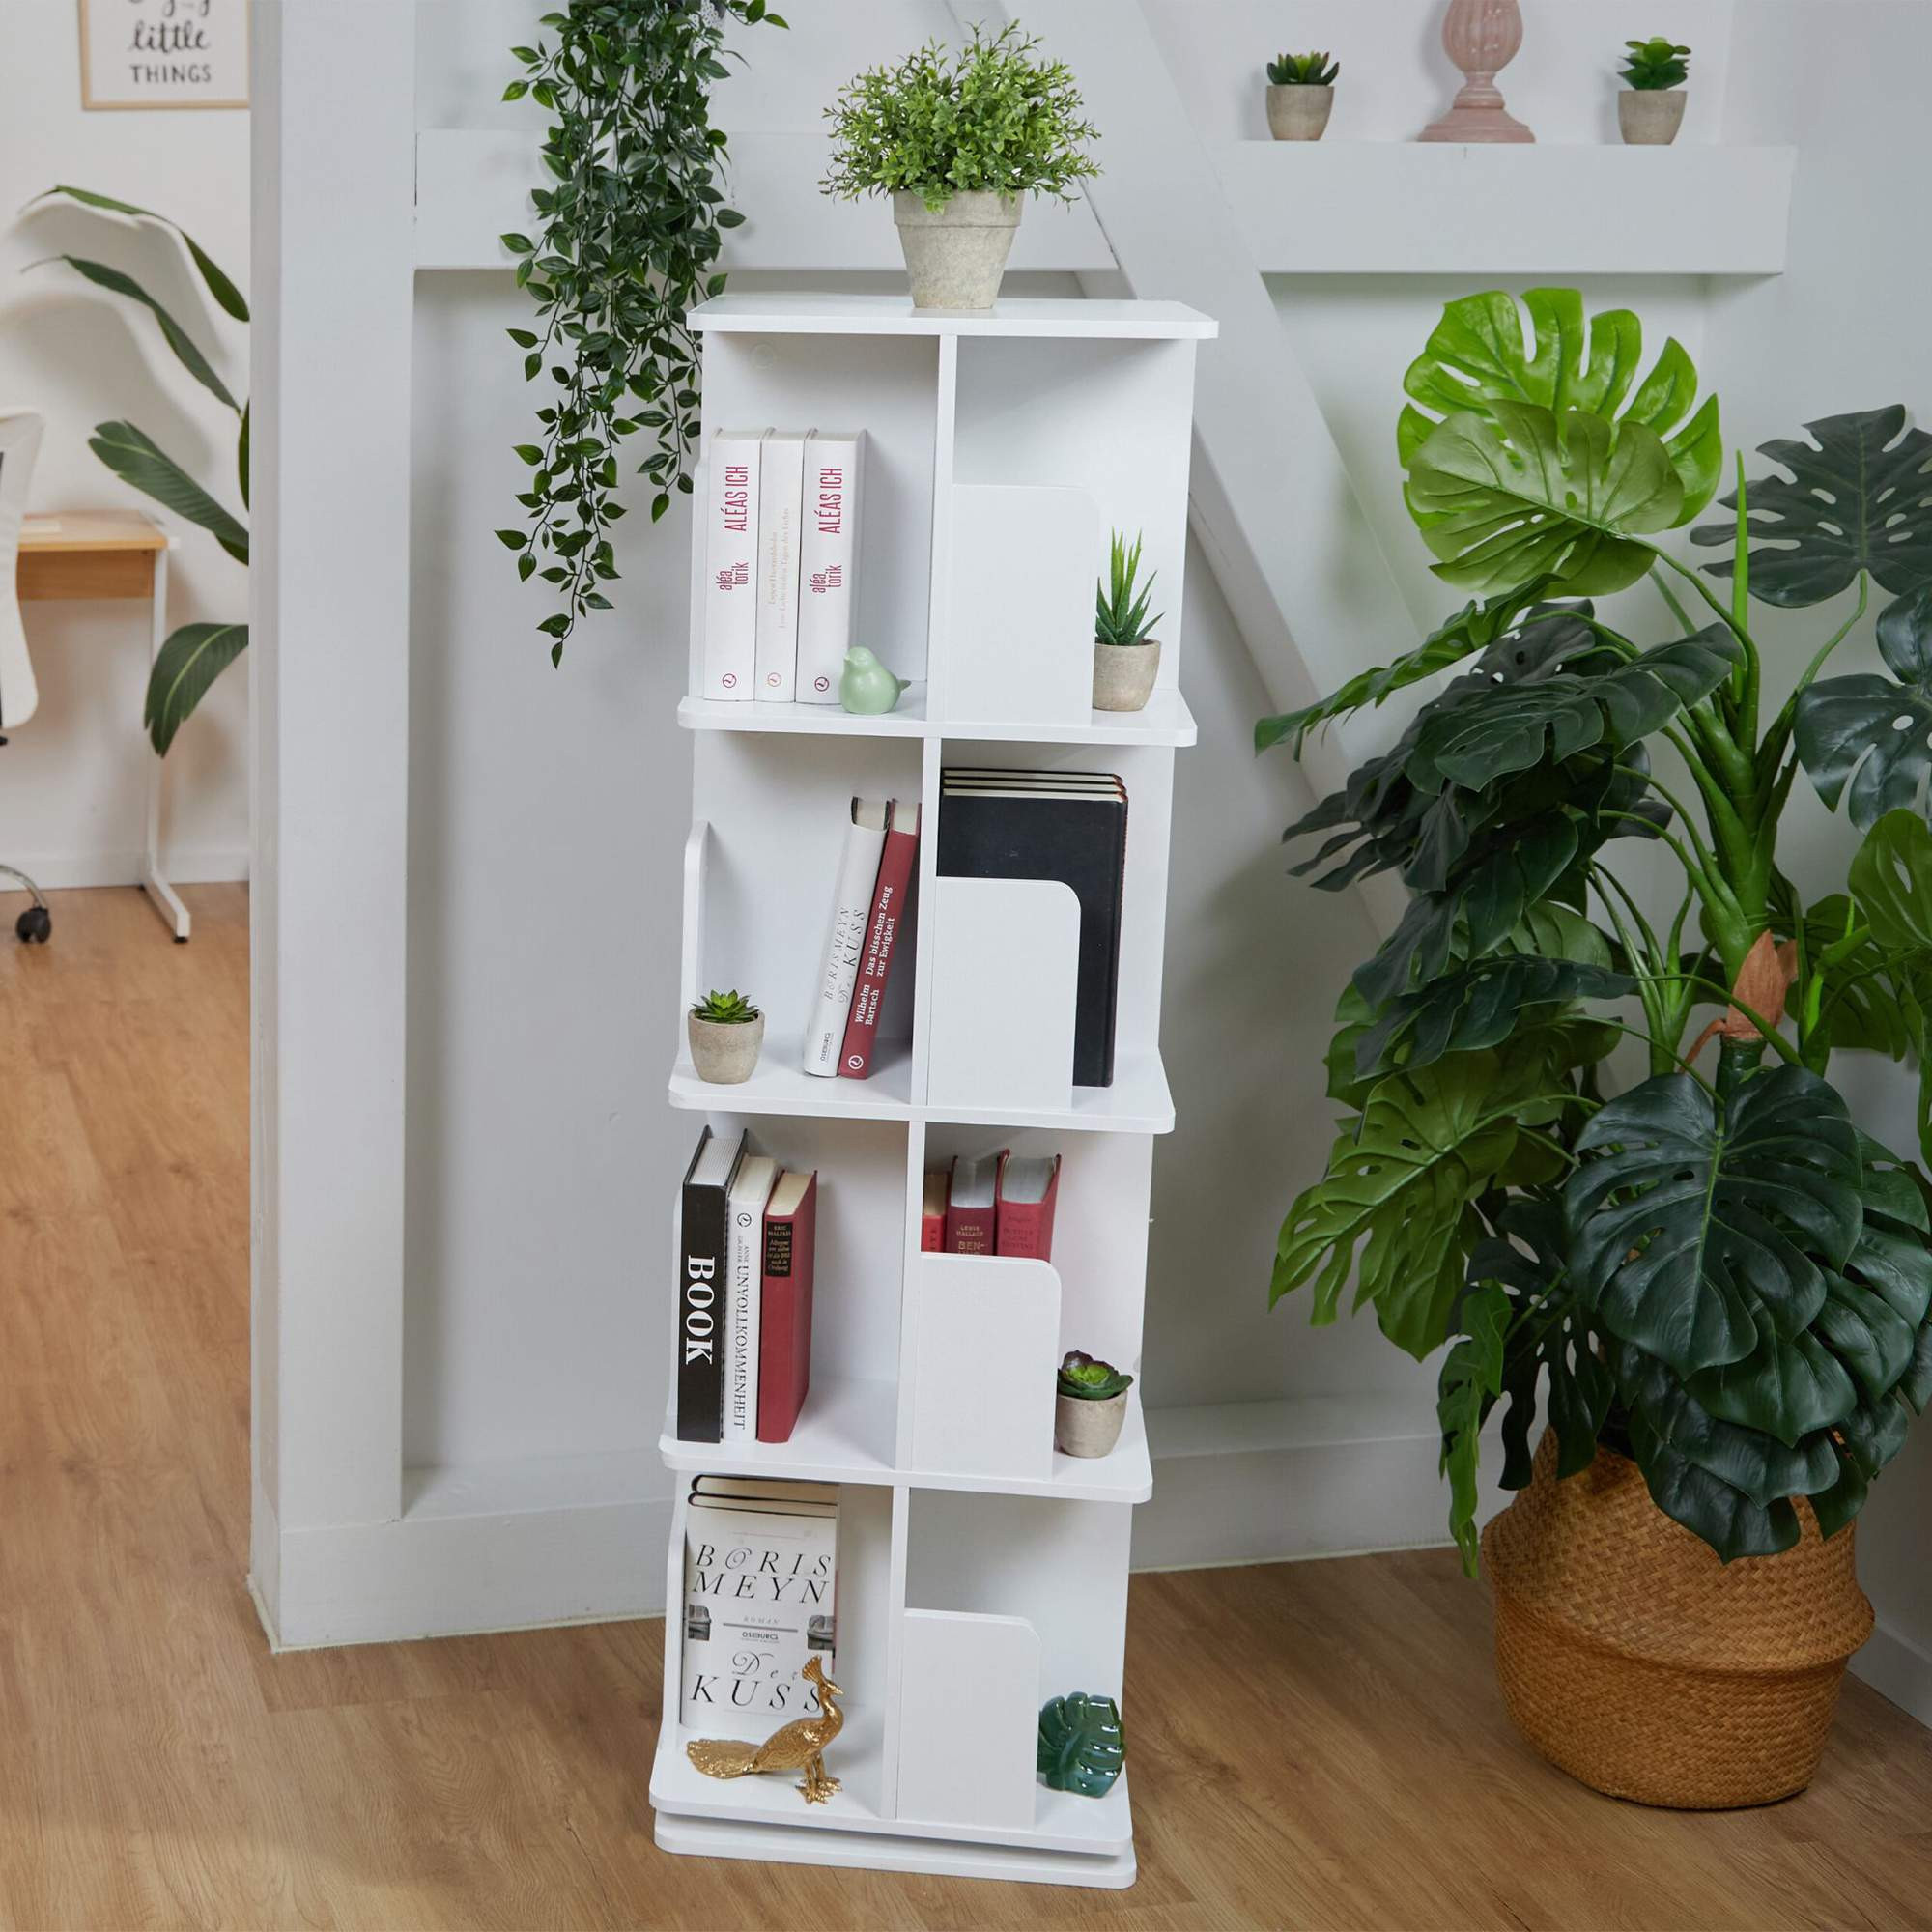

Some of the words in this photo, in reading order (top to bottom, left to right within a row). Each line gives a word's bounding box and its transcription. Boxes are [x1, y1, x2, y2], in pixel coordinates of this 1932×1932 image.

[130, 19, 210, 54] little
[130, 64, 212, 83] THINGS
[725, 466, 748, 487] ICH
[820, 468, 842, 489] ICH
[720, 490, 748, 532] ALÉAS
[814, 493, 841, 533] ALÉAS
[716, 570, 733, 591] aléa
[731, 561, 749, 585] torik
[809, 573, 826, 593] aléa
[825, 564, 842, 588] torik
[878, 885, 893, 909] Zeug
[843, 909, 867, 967] KUSS
[868, 910, 887, 955] bisschen
[880, 917, 895, 959] Ewigkeit
[866, 955, 876, 976] Das
[876, 959, 887, 977] zur
[854, 983, 870, 1024] Wilhelm
[865, 989, 880, 1027] Bartsch
[957, 1240, 986, 1250] BEN-
[685, 1255, 715, 1365] BOOK
[733, 1265, 750, 1430] UNVOLLKOMMENHEIT
[696, 1544, 831, 1577] BORIS
[693, 1571, 830, 1604] MEYN
[690, 1674, 819, 1713] KUSS
